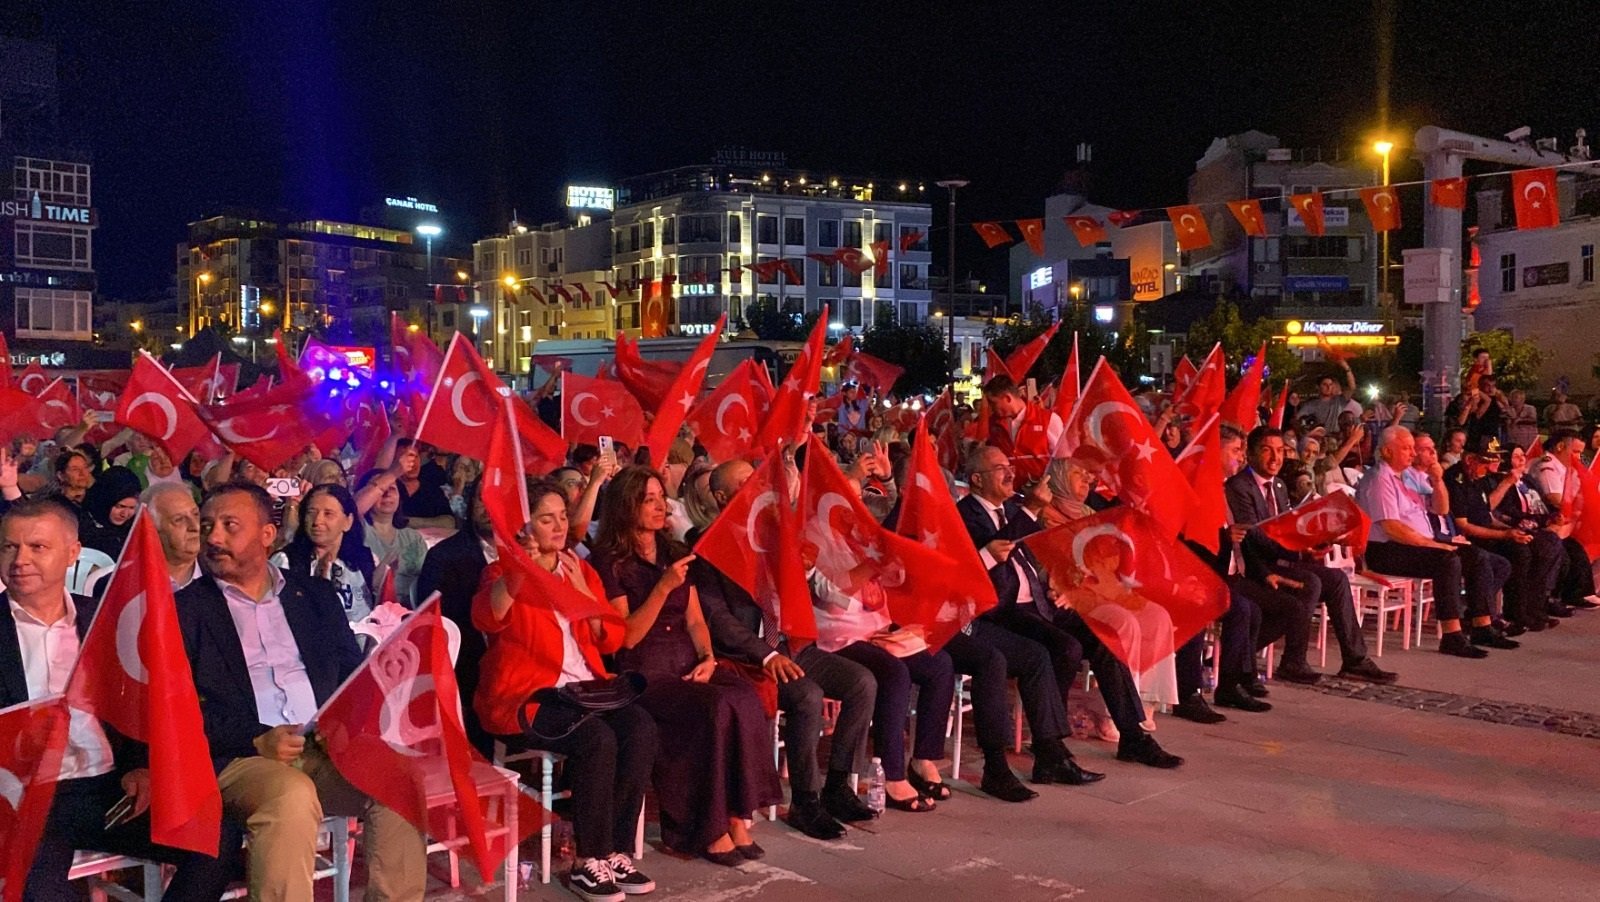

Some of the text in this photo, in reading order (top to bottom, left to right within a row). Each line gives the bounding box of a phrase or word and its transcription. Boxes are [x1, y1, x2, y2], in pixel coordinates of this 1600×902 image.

[0, 201, 90, 223] ISH TIME
[415, 202, 438, 213] HOTEL
[683, 283, 715, 295] KULE
[1135, 281, 1159, 294] OTEL
